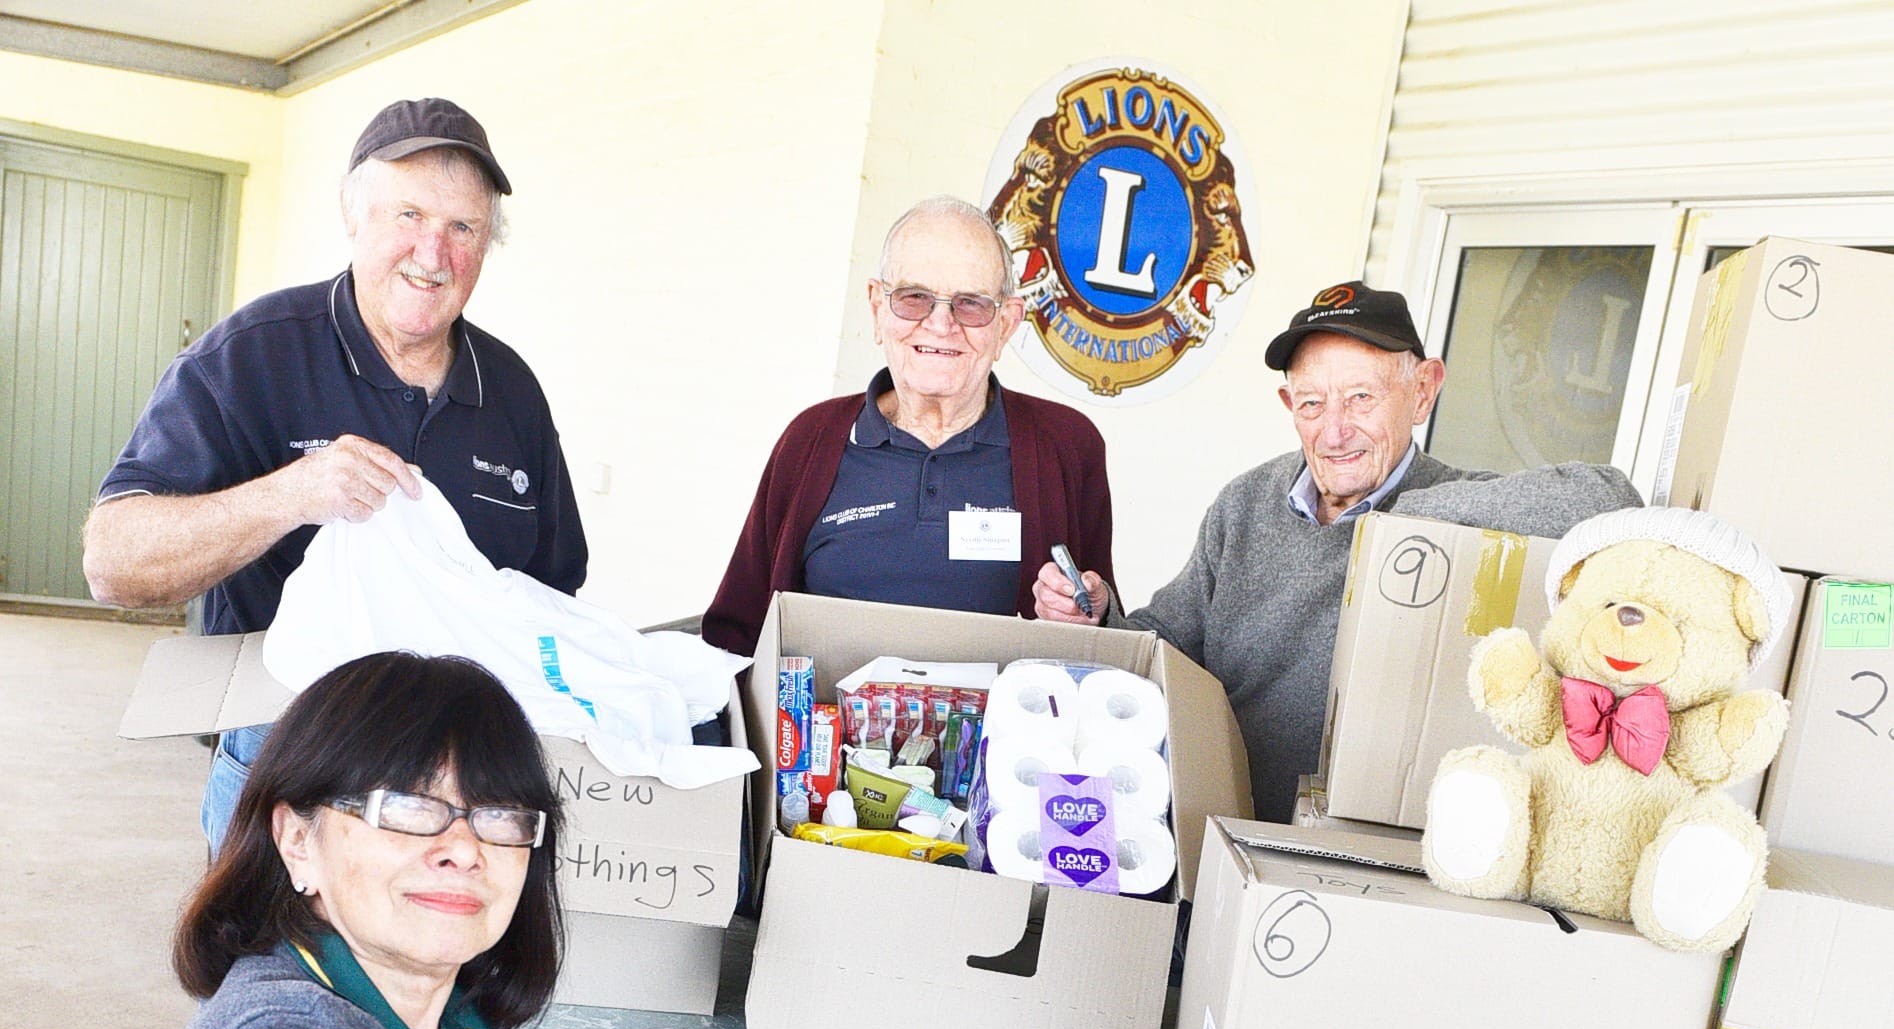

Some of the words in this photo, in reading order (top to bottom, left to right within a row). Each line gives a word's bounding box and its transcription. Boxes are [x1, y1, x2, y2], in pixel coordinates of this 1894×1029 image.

[1073, 86, 1210, 165] LIONS
[1083, 167, 1157, 300] L
[1778, 259, 1808, 298] 2
[1035, 293, 1191, 364] INTERNATIONAL
[822, 514, 837, 524] LIONS
[838, 509, 849, 519] CLUB
[837, 514, 858, 525] DISTRICT
[1394, 547, 1427, 604] 9
[1841, 594, 1879, 607] FINAL
[1831, 612, 1886, 625] CARTON
[779, 720, 794, 767] Colgate
[557, 766, 654, 805] New
[1053, 802, 1099, 816] LOVE
[1053, 813, 1099, 822] HANDLE
[1055, 852, 1101, 865] LOVE
[1056, 863, 1102, 872] HANDLE
